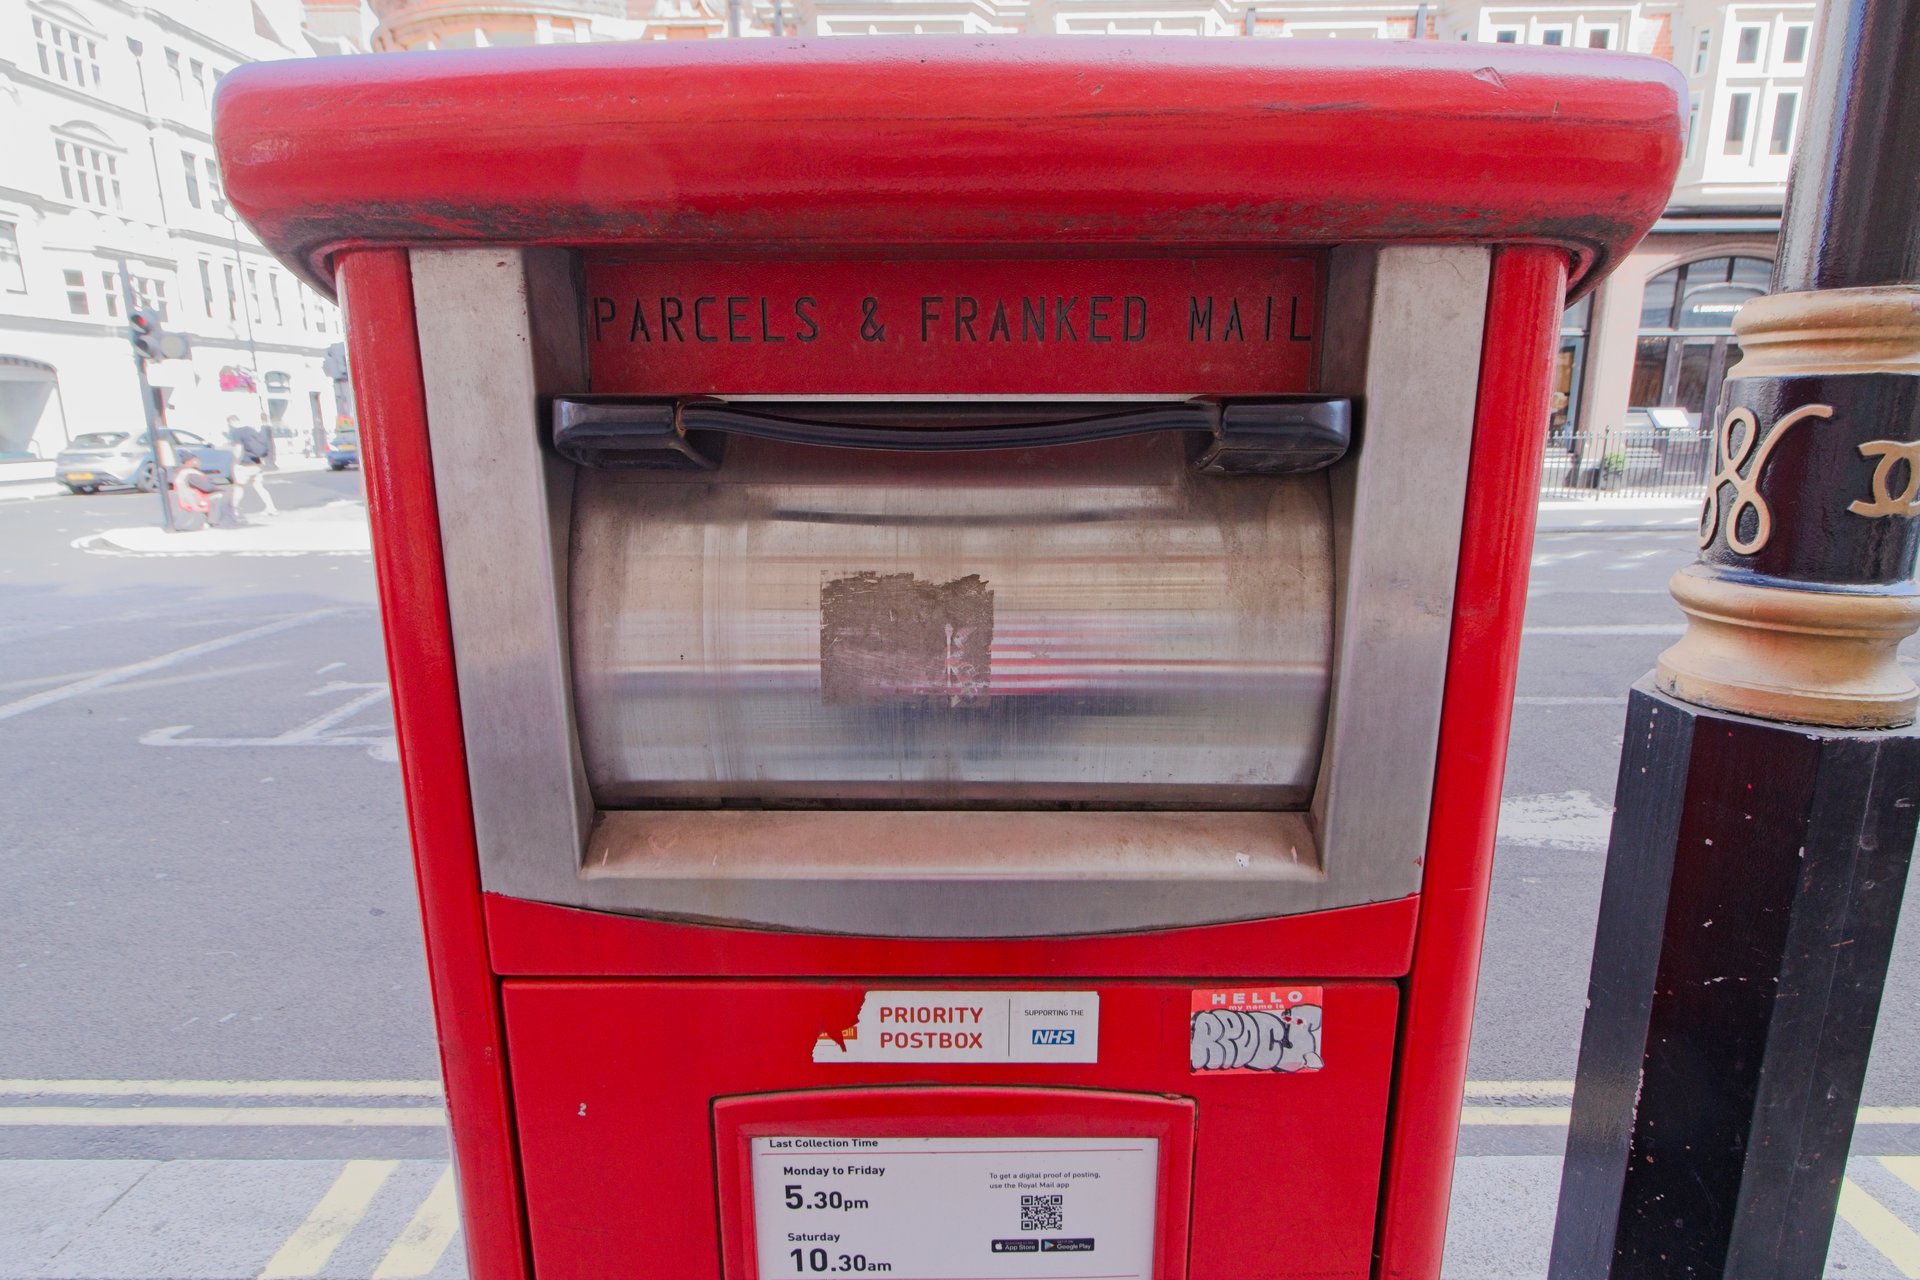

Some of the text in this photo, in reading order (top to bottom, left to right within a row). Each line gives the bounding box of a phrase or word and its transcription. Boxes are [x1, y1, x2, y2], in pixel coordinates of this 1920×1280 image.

[593, 296, 1312, 343] PARCELS & FRANKED MAIL
[1211, 991, 1303, 1005] HELLO
[879, 1006, 984, 1024] PRIORITY
[1024, 1009, 1069, 1017] SUPPORTING
[879, 1032, 984, 1049] POSTBOX
[1033, 1030, 1073, 1044] NHS
[769, 1138, 879, 1148] Last Collection Time
[783, 1165, 886, 1177] Monday to Friday
[999, 1172, 1011, 1181] get
[1019, 1172, 1042, 1180] digital
[1043, 1172, 1062, 1180] proof
[1018, 1181, 1038, 1190] Royal
[1039, 1181, 1055, 1189] Mail
[1056, 1182, 1070, 1190] app
[784, 1184, 869, 1212] 5.30pm
[787, 1232, 841, 1243] Saturday
[789, 1247, 892, 1272] 10.30am
